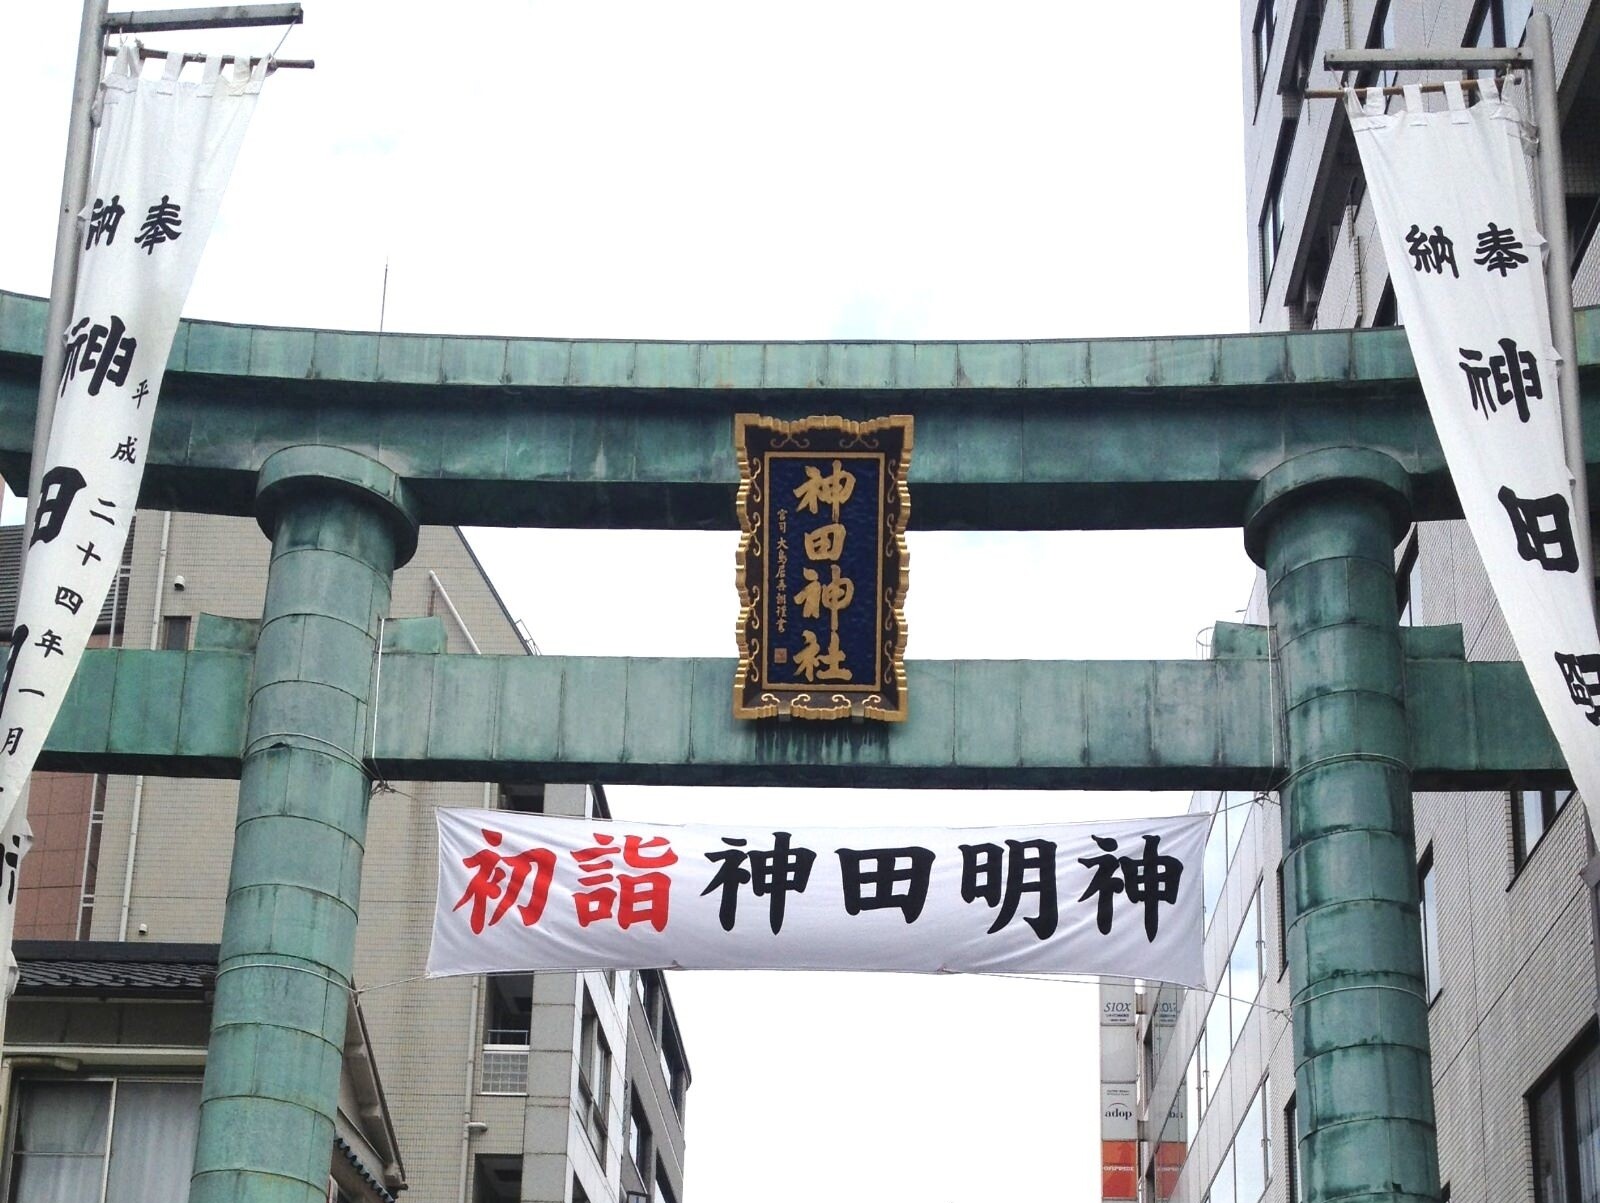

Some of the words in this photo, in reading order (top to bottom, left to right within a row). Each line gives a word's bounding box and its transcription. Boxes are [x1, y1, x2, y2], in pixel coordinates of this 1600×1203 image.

[84, 195, 183, 255] 奉納
[1404, 223, 1530, 278] 奉納
[793, 460, 857, 682] 神田神社
[1105, 1108, 1133, 1121] adop
